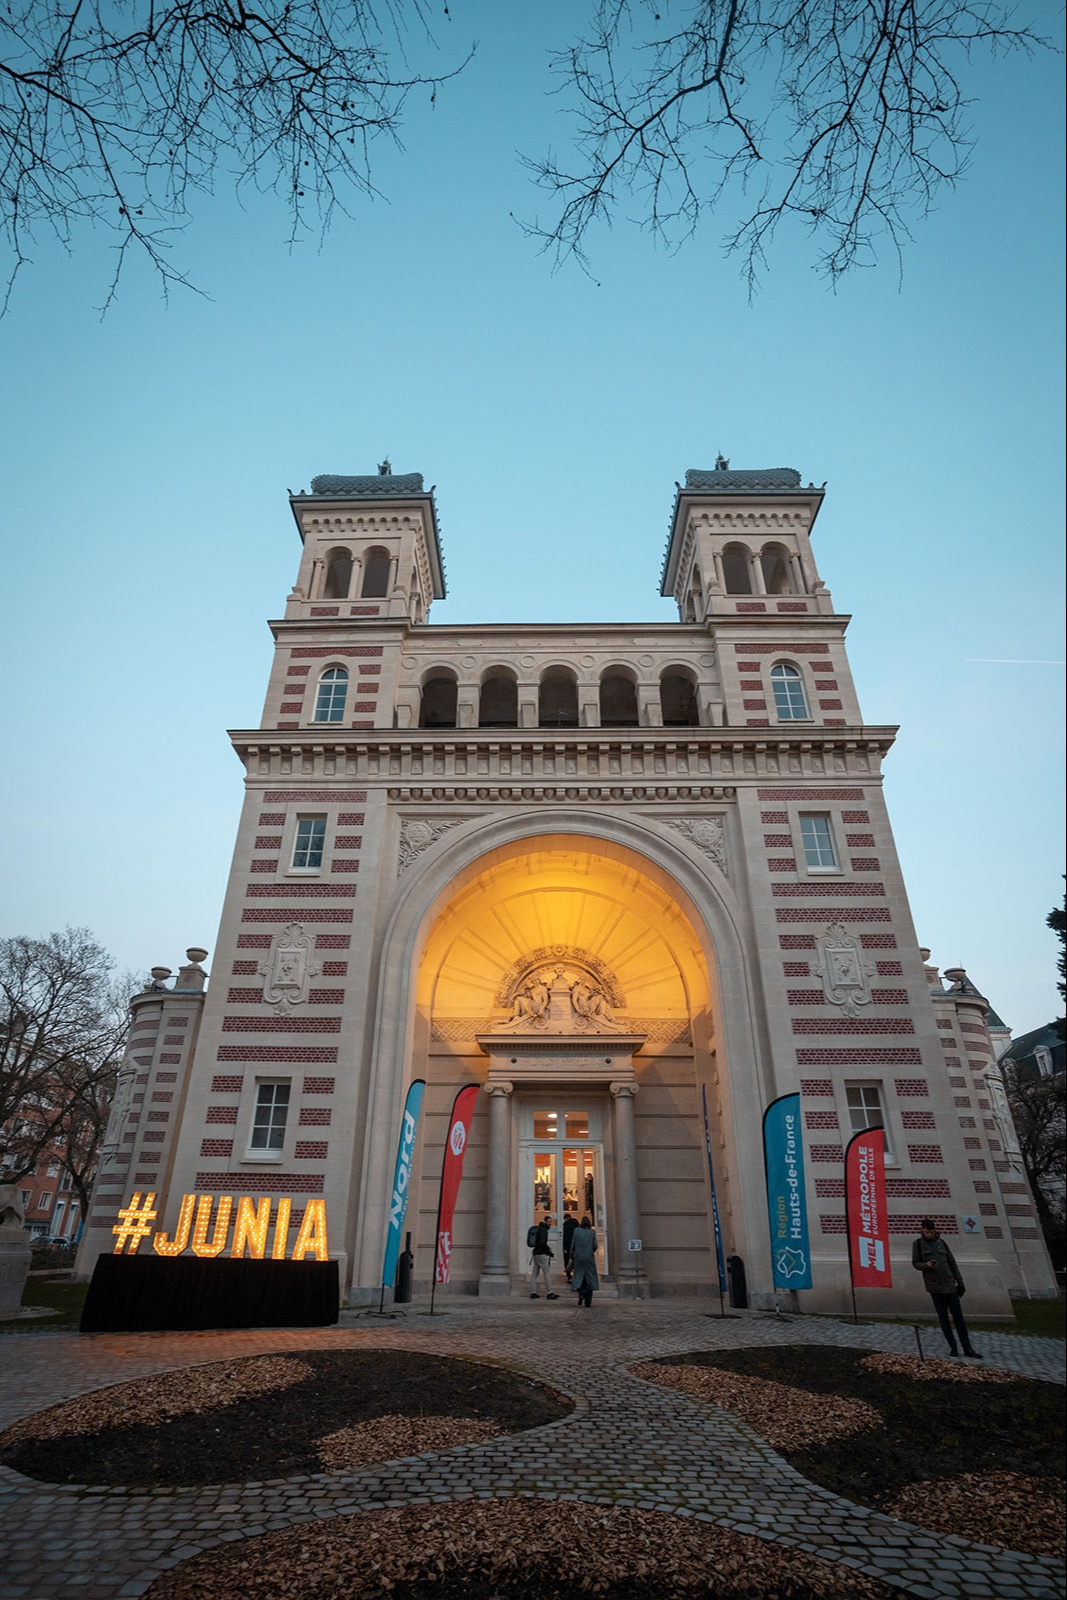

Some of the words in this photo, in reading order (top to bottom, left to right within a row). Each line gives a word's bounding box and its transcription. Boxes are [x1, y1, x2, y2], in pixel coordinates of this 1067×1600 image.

[389, 1109, 416, 1230] Nord
[785, 1114, 802, 1239] Hauts-de-France
[859, 1146, 872, 1233] MÉTROPOLE
[869, 1170, 876, 1181] DE
[111, 1191, 329, 1261] #JUNIA
[776, 1195, 788, 1239] Région
[870, 1183, 879, 1235] EUROPÉENNE
